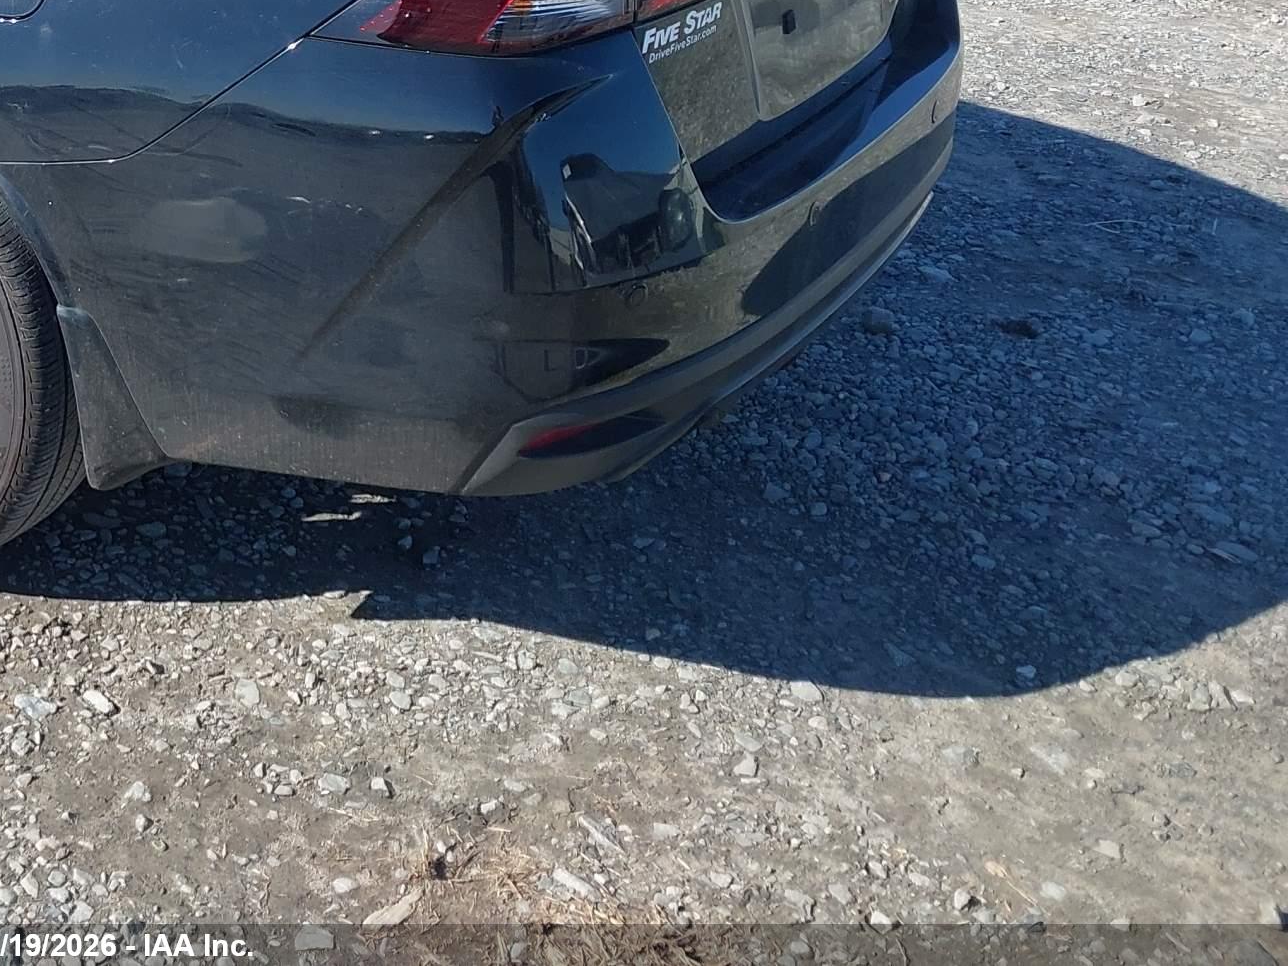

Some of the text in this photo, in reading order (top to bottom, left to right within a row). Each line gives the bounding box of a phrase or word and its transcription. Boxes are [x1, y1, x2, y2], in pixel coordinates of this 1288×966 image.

[642, 0, 723, 55] FIVE STAR
[648, 25, 717, 65] DriveFiveStar.com
